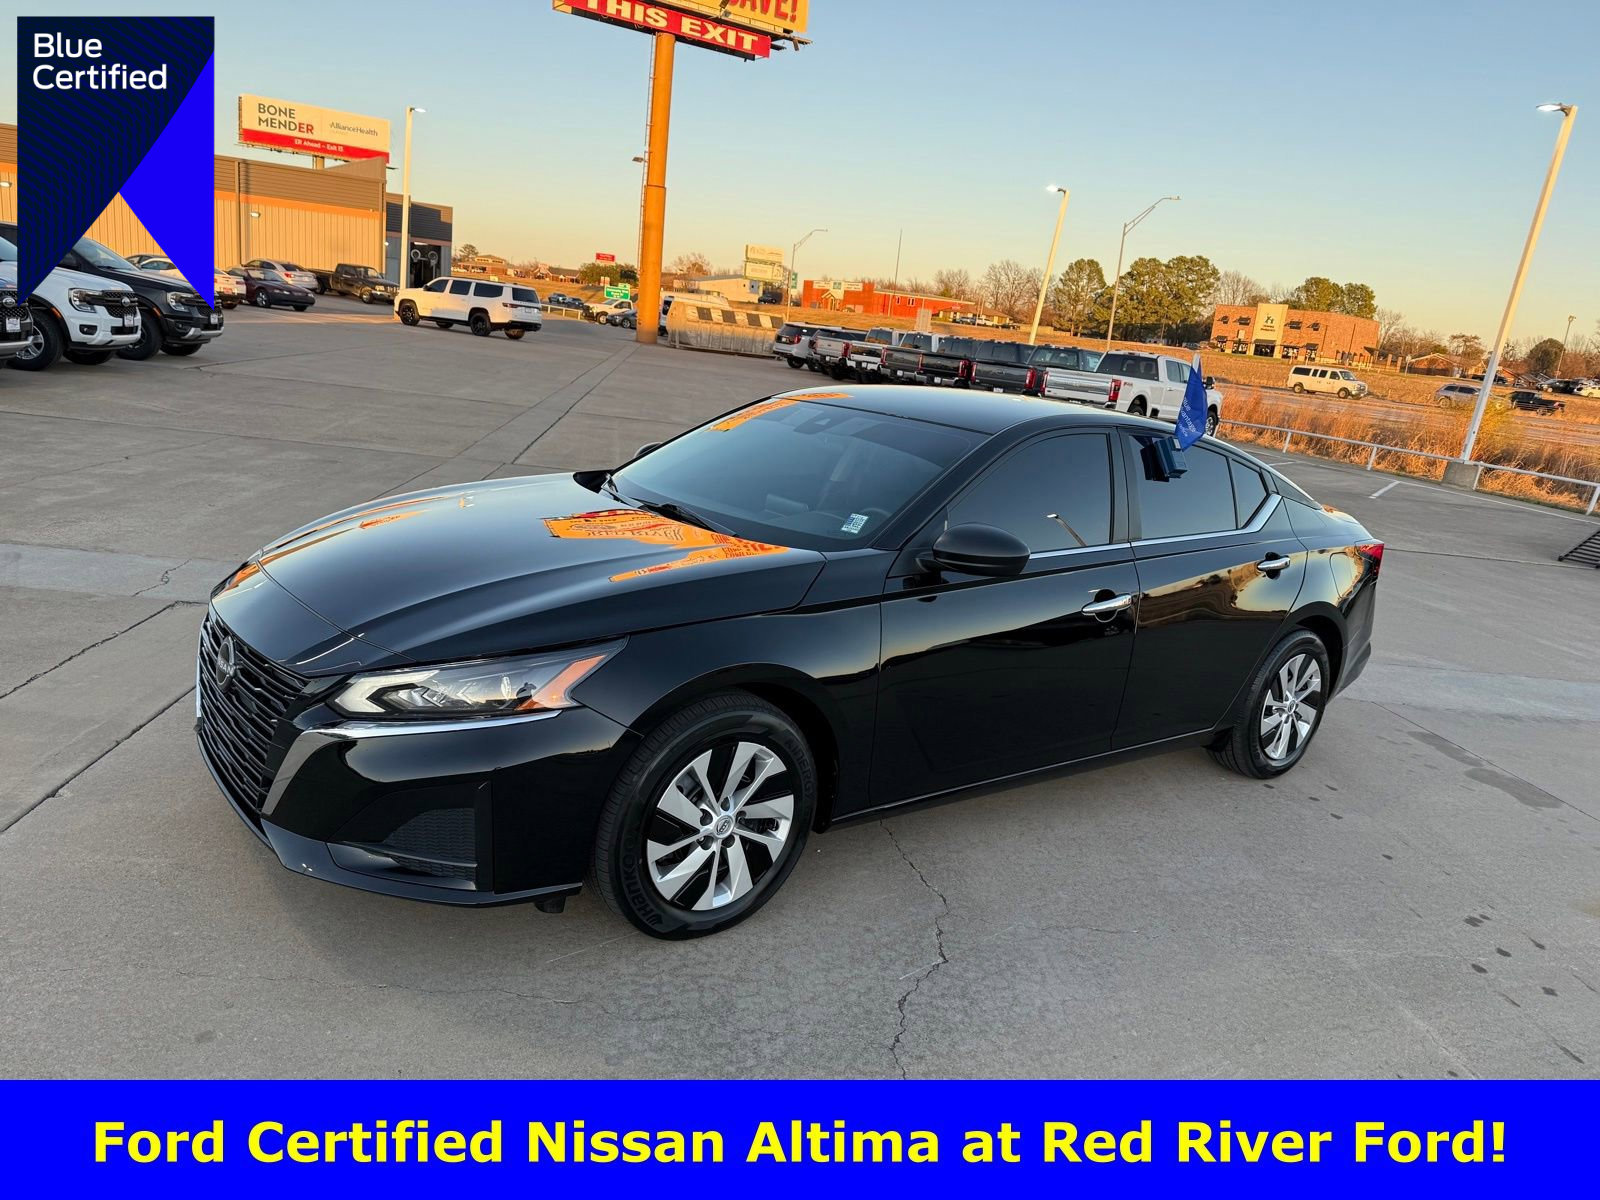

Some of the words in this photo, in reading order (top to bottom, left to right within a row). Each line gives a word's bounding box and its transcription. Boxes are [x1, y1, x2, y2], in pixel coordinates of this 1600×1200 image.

[680, 16, 758, 50] EXIT
[258, 103, 296, 119] BONE
[258, 117, 314, 135] MENDER
[330, 121, 378, 136] AllianceHealth
[303, 140, 321, 149] Ahead
[326, 143, 337, 151] Exit
